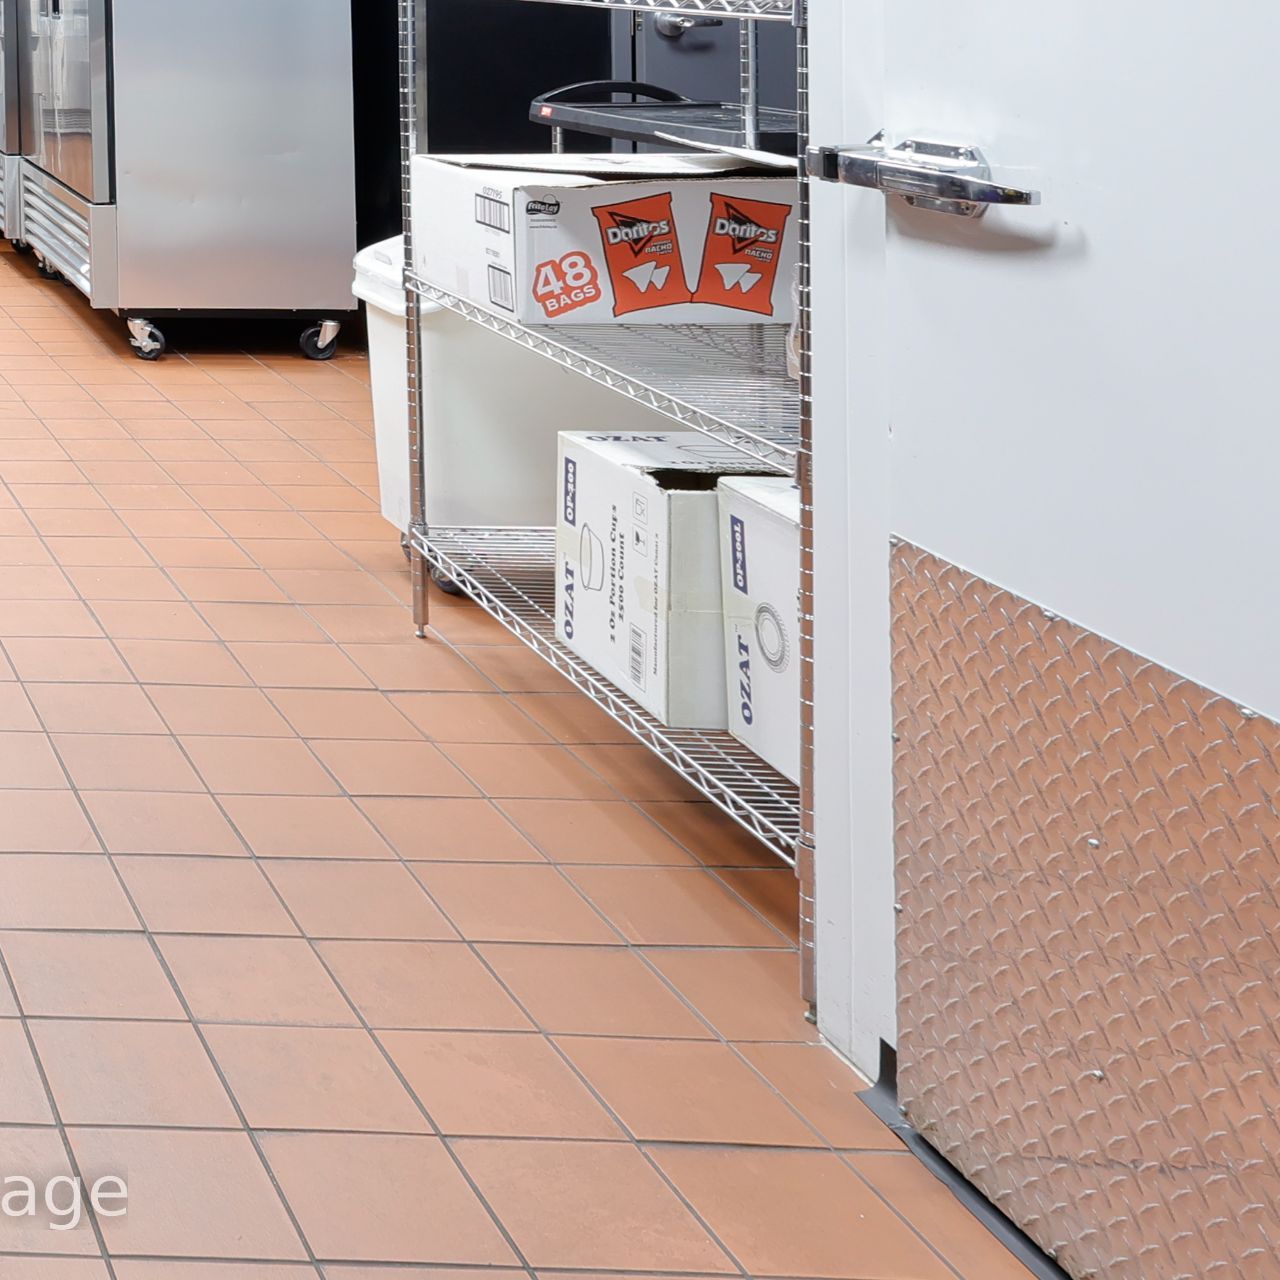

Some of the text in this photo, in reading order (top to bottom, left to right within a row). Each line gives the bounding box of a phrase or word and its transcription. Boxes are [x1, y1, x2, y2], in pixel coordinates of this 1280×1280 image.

[606, 219, 671, 245] Doritos
[714, 217, 779, 244] Doritos
[536, 255, 592, 296] 48
[544, 284, 597, 311] BAGS
[566, 463, 575, 520] OP-200
[609, 504, 618, 543] Cups
[617, 532, 625, 581] Count
[734, 522, 745, 587] OP-200L
[564, 560, 575, 640] OZAT
[608, 612, 616, 630] Oz
[736, 634, 753, 725] OZAT
